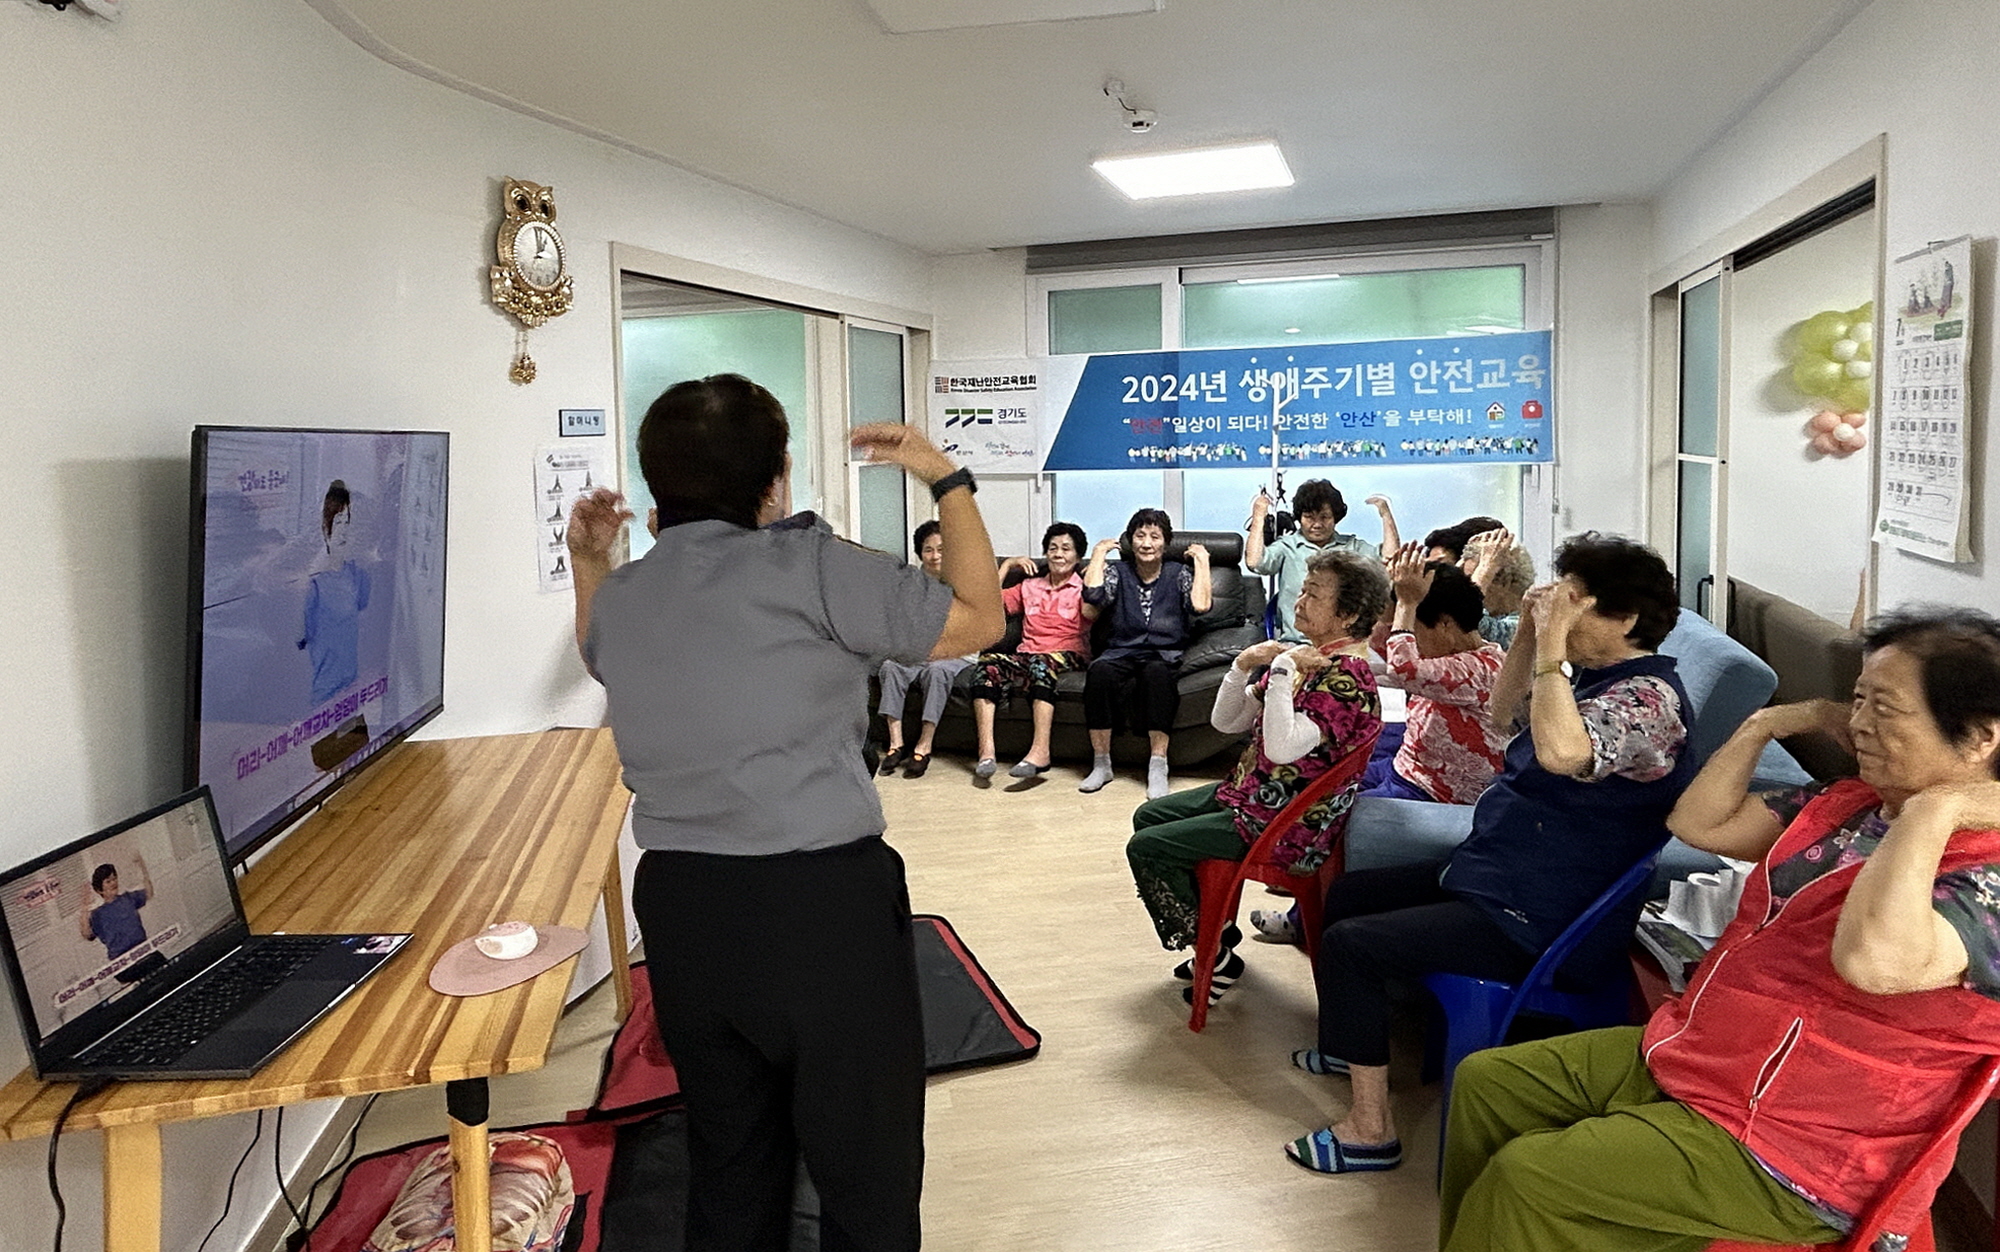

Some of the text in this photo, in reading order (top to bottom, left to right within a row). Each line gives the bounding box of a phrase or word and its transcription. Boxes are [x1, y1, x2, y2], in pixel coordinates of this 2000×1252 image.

[950, 374, 1037, 387] 한국재난안전교육협회
[1121, 353, 1546, 403] 2024년 생애주기별 안전교육
[997, 408, 1027, 419] 경기도
[1226, 415, 1268, 432] 되다!
[1277, 413, 1328, 431] 안전한
[1407, 408, 1472, 427] 부탁해!
